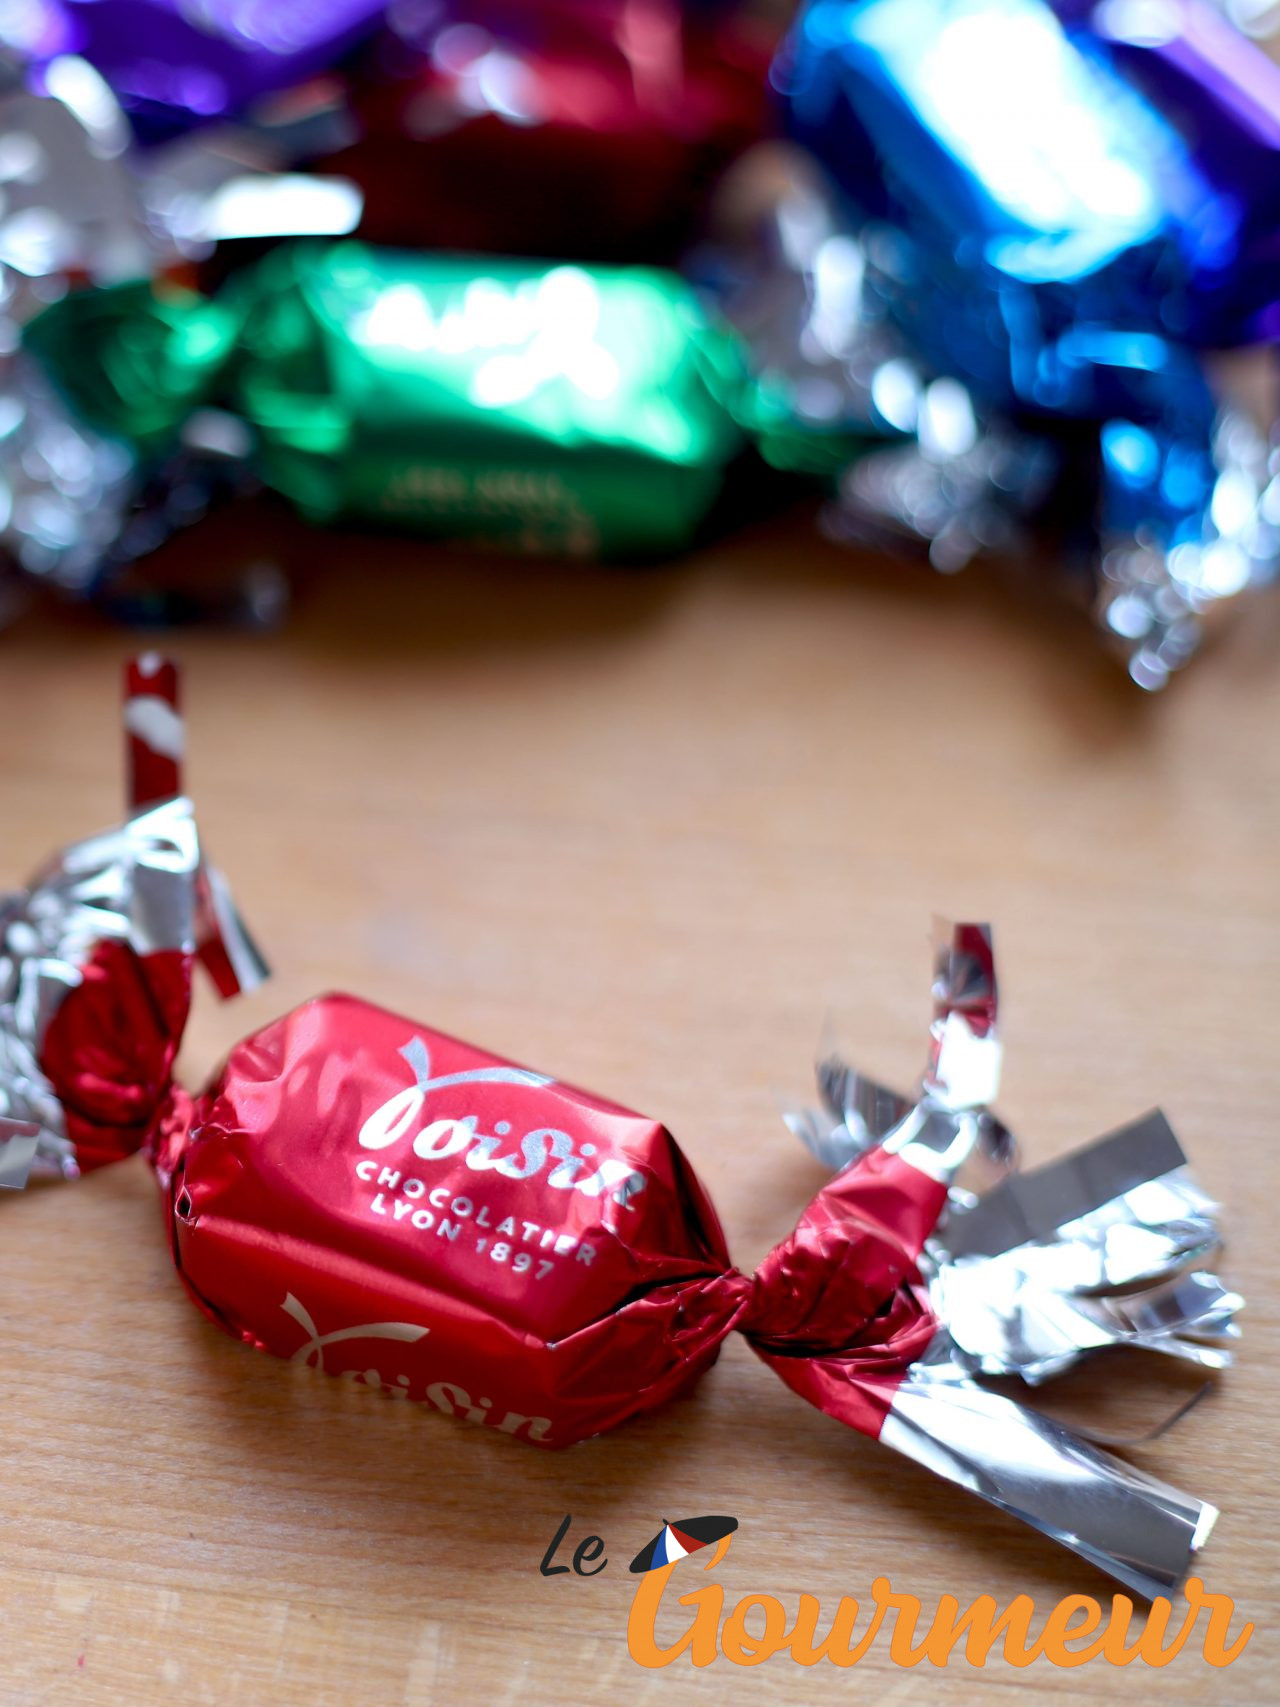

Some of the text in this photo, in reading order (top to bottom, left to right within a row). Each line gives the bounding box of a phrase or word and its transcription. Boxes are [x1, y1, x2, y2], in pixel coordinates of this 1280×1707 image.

[358, 1034, 647, 1212] Voisin
[354, 1160, 598, 1267] CHOCOLATIER
[370, 1192, 555, 1281] LYON 1897
